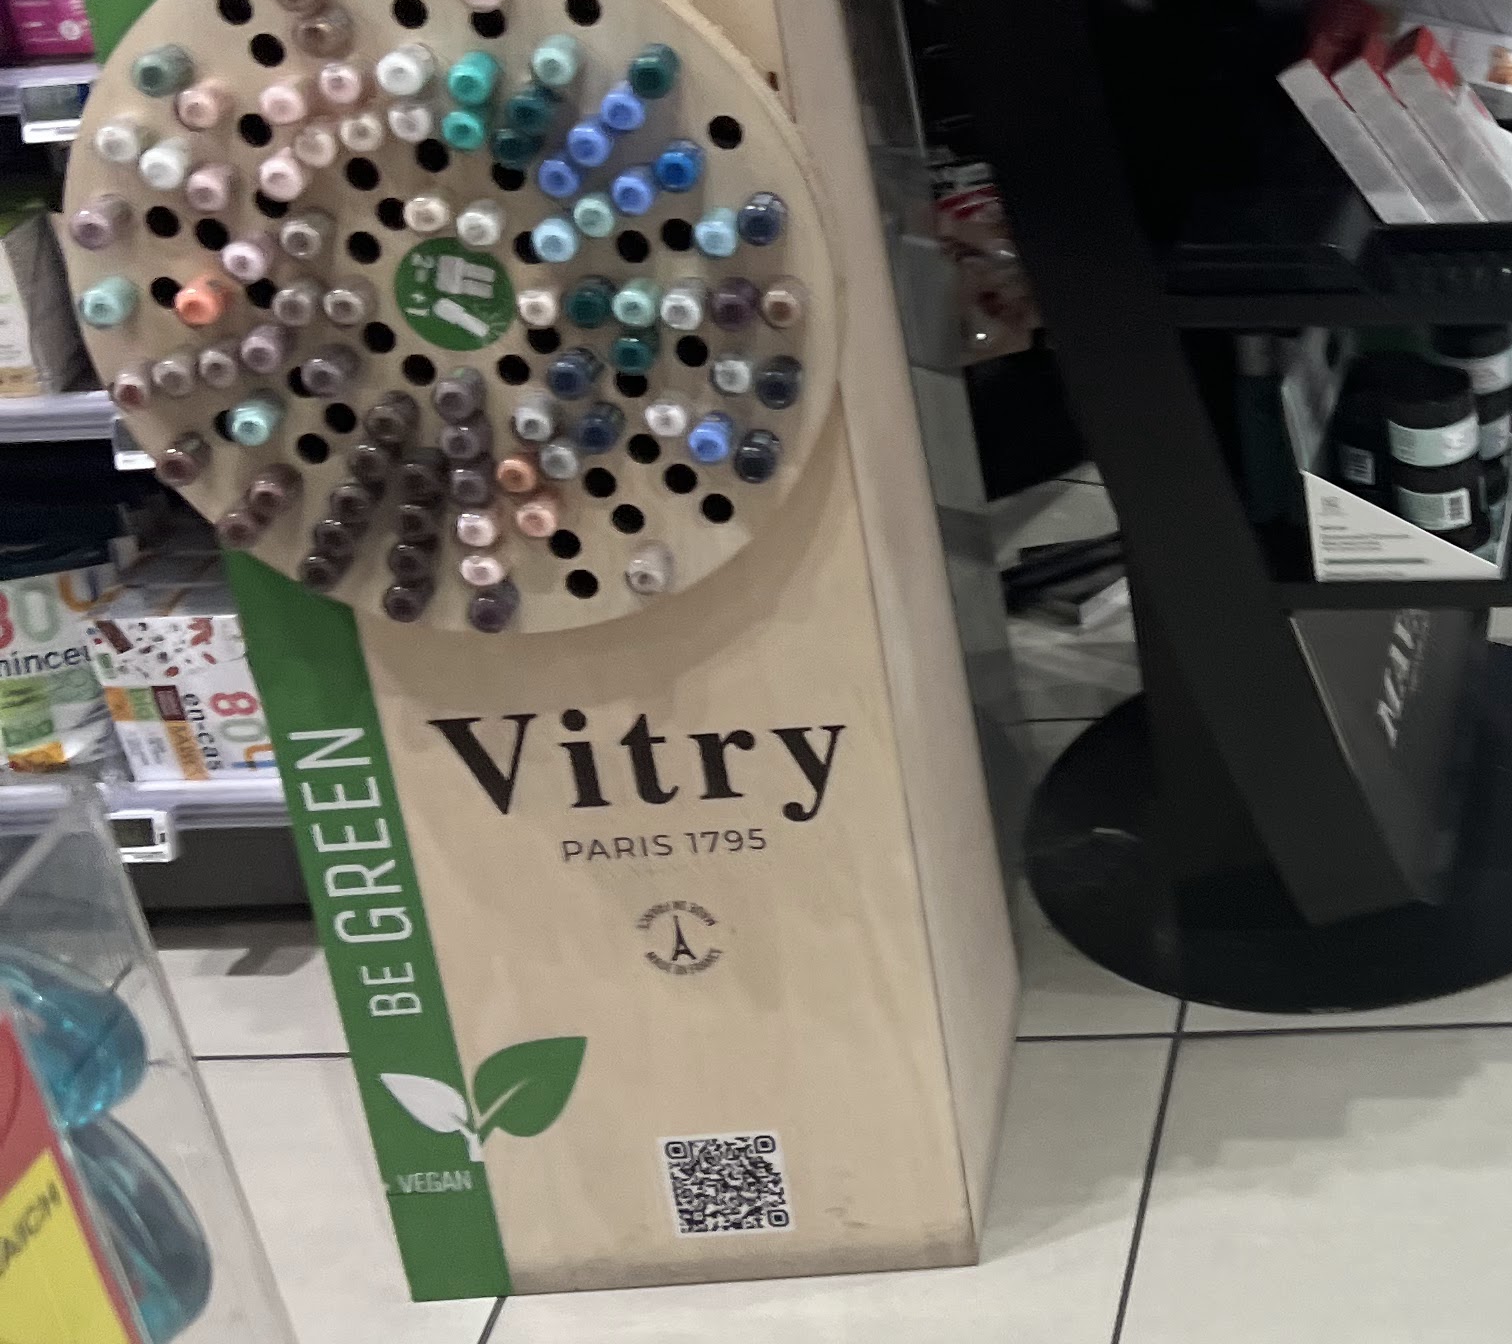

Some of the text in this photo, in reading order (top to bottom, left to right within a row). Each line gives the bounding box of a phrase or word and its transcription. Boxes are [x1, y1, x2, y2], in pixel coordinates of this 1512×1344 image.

[427, 709, 847, 823] Vitry
[288, 727, 423, 1017] BE GREEN
[561, 828, 768, 863] PARIS 1795
[397, 1170, 473, 1194] VEGAN
